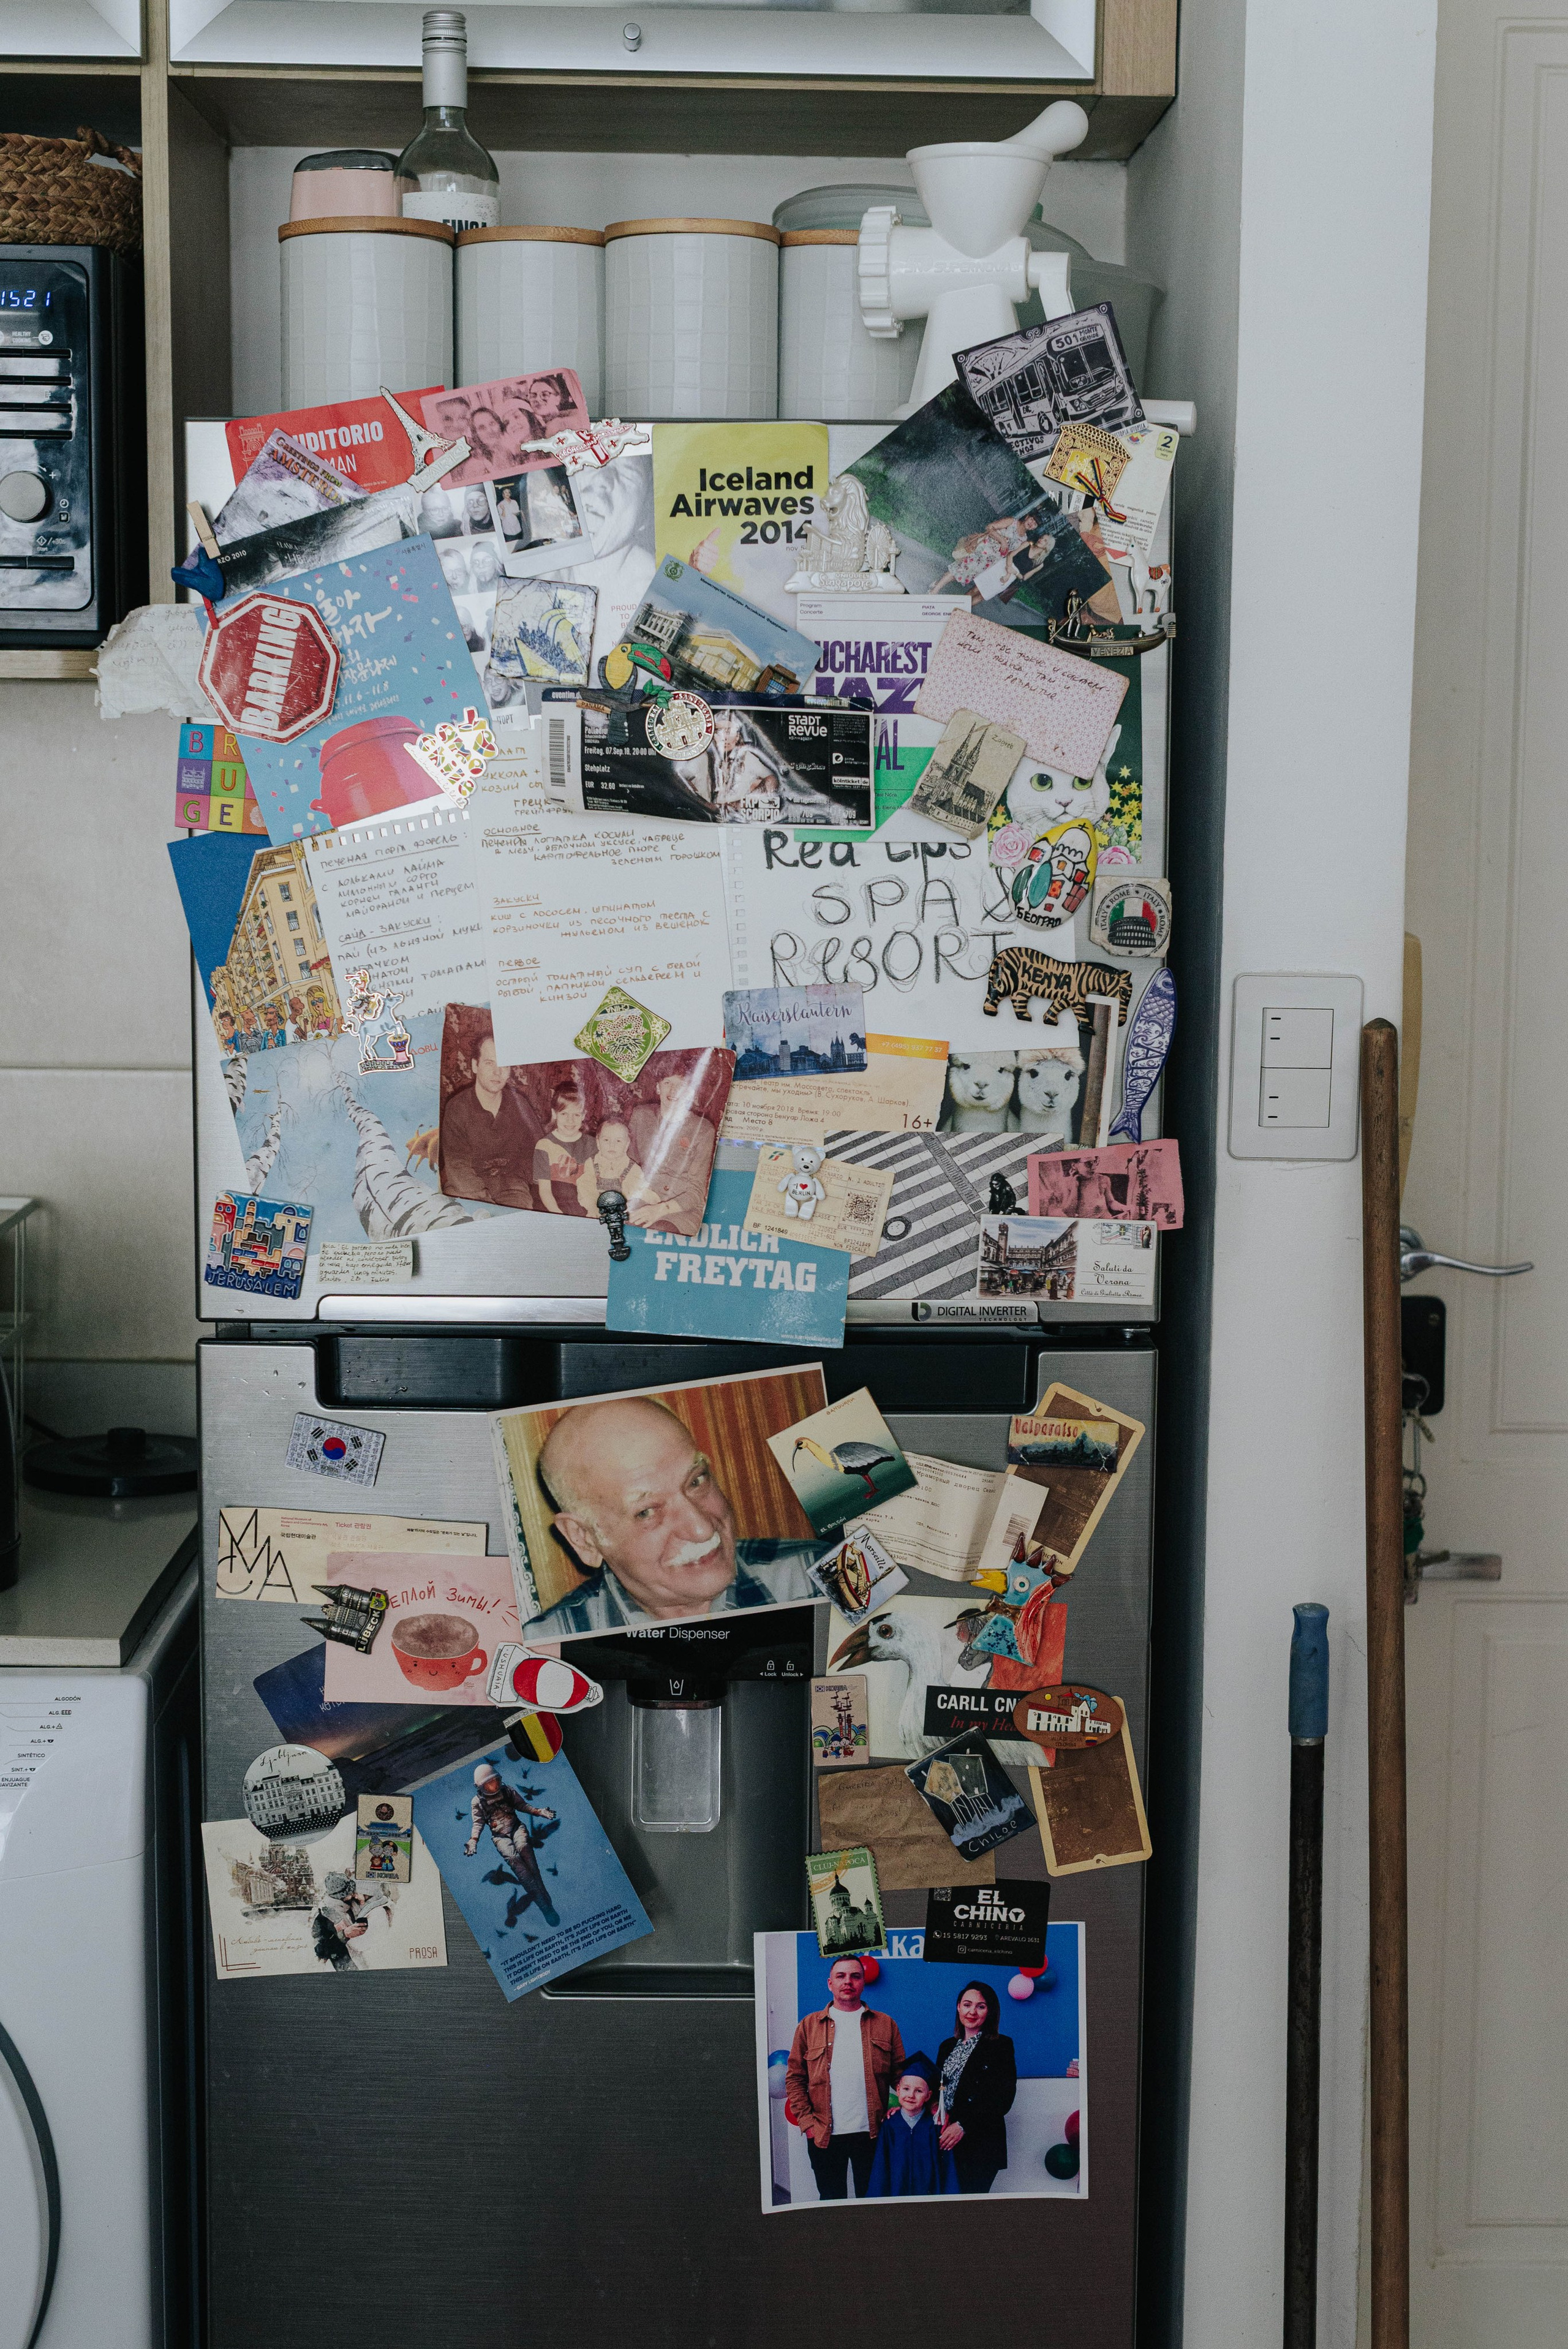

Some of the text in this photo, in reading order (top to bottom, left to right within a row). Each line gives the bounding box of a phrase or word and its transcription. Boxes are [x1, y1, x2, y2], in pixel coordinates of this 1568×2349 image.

[1079, 326, 1098, 336] MONTE
[1079, 333, 1099, 342] GRANDE
[1056, 334, 1079, 349] 501
[294, 421, 384, 452] UDITORIO
[1011, 437, 1044, 448] ECTIVOS
[1161, 435, 1173, 448] 2
[266, 448, 345, 505] AMSTERD
[320, 469, 343, 488] FROM
[699, 466, 813, 491] Iceland
[670, 492, 814, 517] Airwaves
[740, 521, 812, 545] 2014
[232, 550, 247, 560] 2010
[819, 573, 873, 591] Singapore
[611, 603, 637, 613] PROUD
[815, 641, 932, 674] UCHAREST
[1091, 647, 1133, 656] VENEZIA
[241, 607, 301, 730] BARKING
[581, 702, 605, 711] PANAMA
[584, 726, 608, 735] Palladiu
[991, 734, 1014, 750] Zagreb
[585, 764, 611, 773] Stehplatz
[741, 798, 758, 809] FKP
[741, 809, 780, 821] SCORPIO
[813, 875, 960, 926] SPA
[1109, 890, 1161, 908] ROME ITALY
[1016, 907, 1061, 927] БЕОГРАД
[1157, 915, 1166, 939] ROME
[1021, 962, 1072, 991] KENYA
[605, 1004, 631, 1012] CHINA
[736, 1001, 853, 1026] Kaiserslautern
[892, 1042, 909, 1050] (495)
[777, 1104, 794, 1113] 2018
[743, 1117, 766, 1126] Место
[774, 1112, 799, 1122] Бенуар
[800, 1114, 819, 1123] Ложа
[902, 1112, 933, 1130] 16+
[765, 1225, 788, 1235] 1241849
[655, 1251, 817, 1293] FREYTAG
[1093, 1261, 1121, 1272] Saluti
[208, 1270, 296, 1297] JERUSALEM
[1094, 1273, 1131, 1285] Verona
[937, 1306, 1027, 1316] DIGITAL INVERTER
[916, 1470, 980, 1492] Мраморный дворец
[853, 1532, 886, 1570] Marseille
[388, 1581, 435, 1608] ЕПЛОЙ
[358, 1610, 381, 1652] LÜBECK
[626, 1627, 731, 1641] Water Dispenser
[937, 1694, 989, 1711] CARLL
[950, 1715, 965, 1729] In
[260, 1749, 307, 1773] Ljubljana
[977, 1889, 1005, 1905] EL
[611, 1909, 628, 1920] EARTH
[953, 1905, 1026, 1923] CHINO
[541, 1936, 556, 1946] NEED
[582, 1912, 605, 1926] FUCKING
[606, 1904, 622, 1915] HARD
[953, 1921, 1023, 1931] CARNICERIA
[409, 1947, 438, 1959] PROSA
